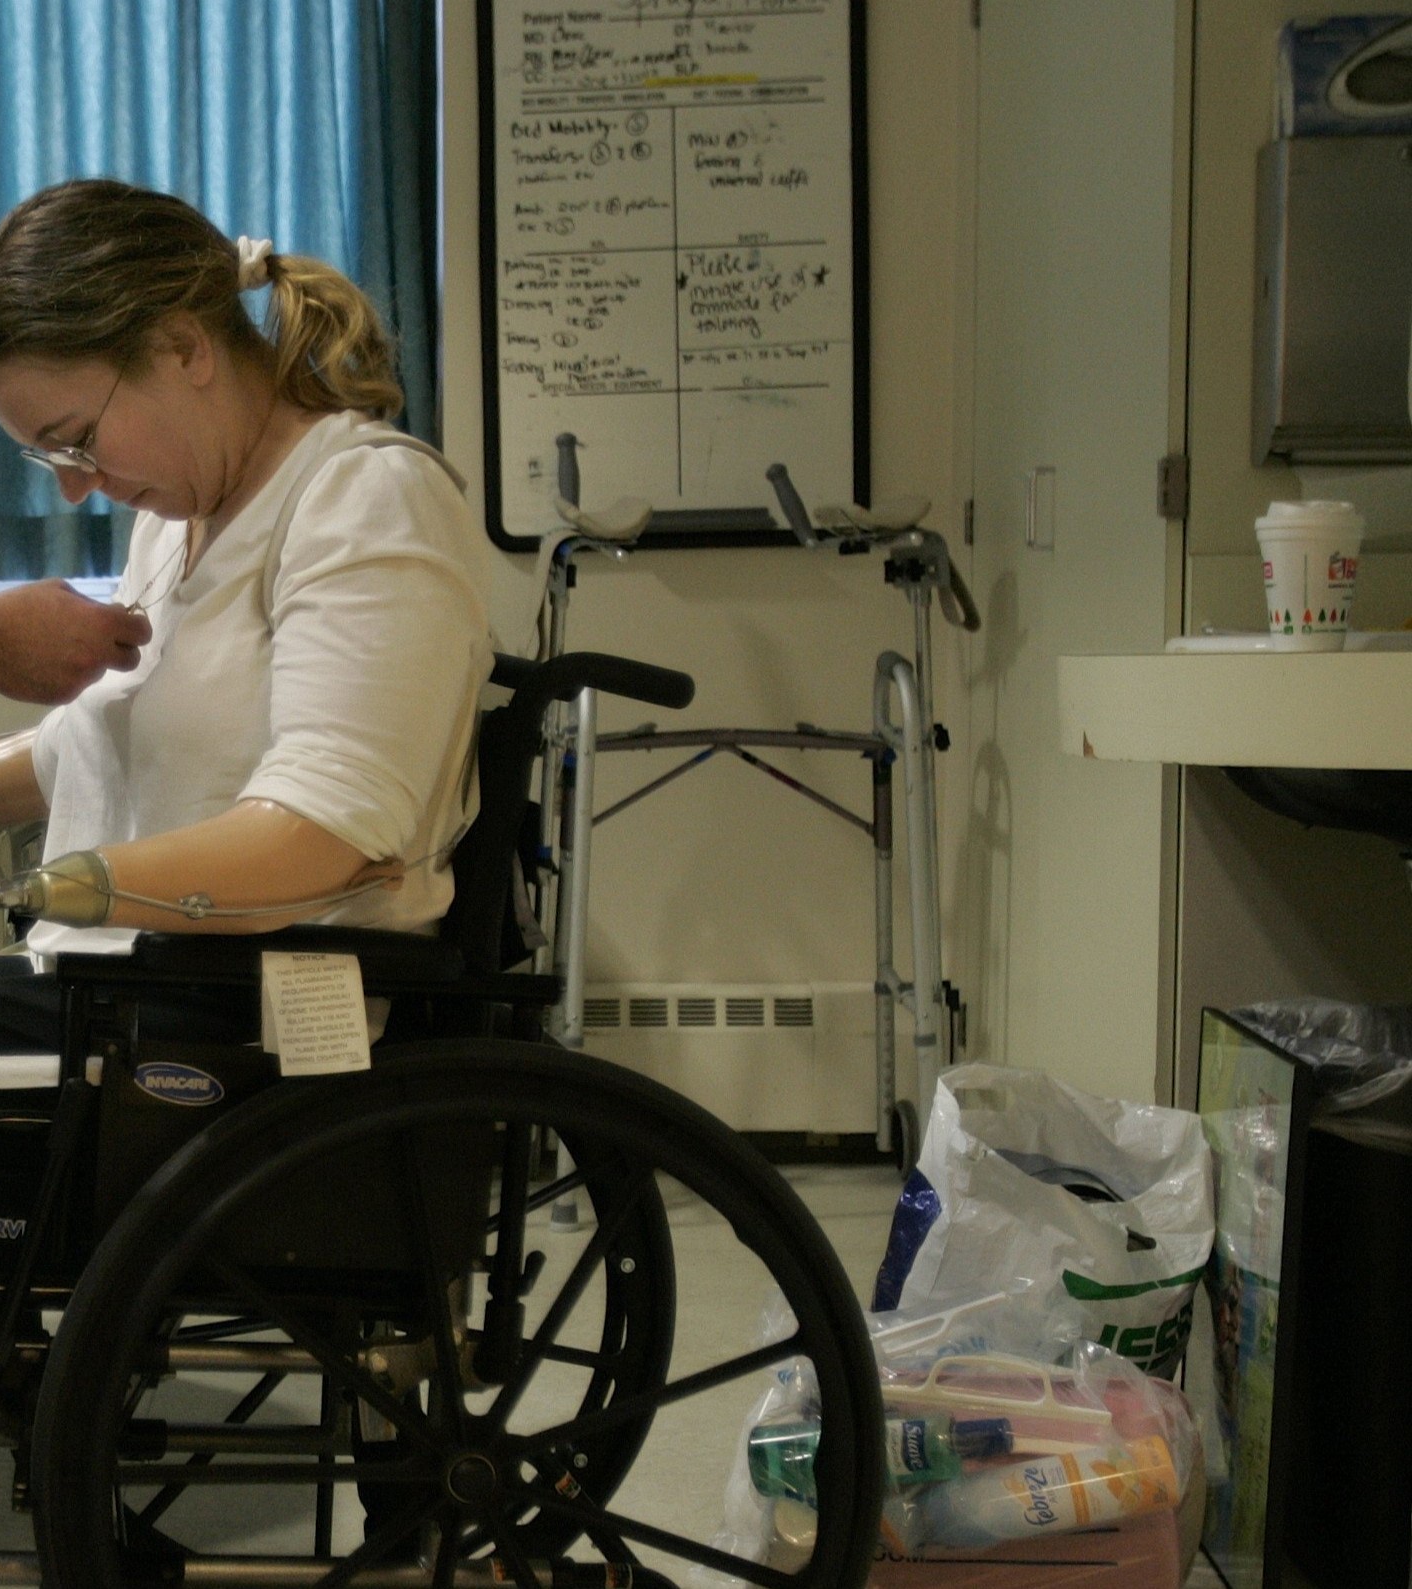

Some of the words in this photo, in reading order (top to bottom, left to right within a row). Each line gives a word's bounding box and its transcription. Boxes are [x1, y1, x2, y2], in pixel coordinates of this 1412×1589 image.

[292, 954, 326, 962] NOTICE
[905, 1420, 925, 1473] Suave
[1024, 1465, 1059, 1528] Febreze
